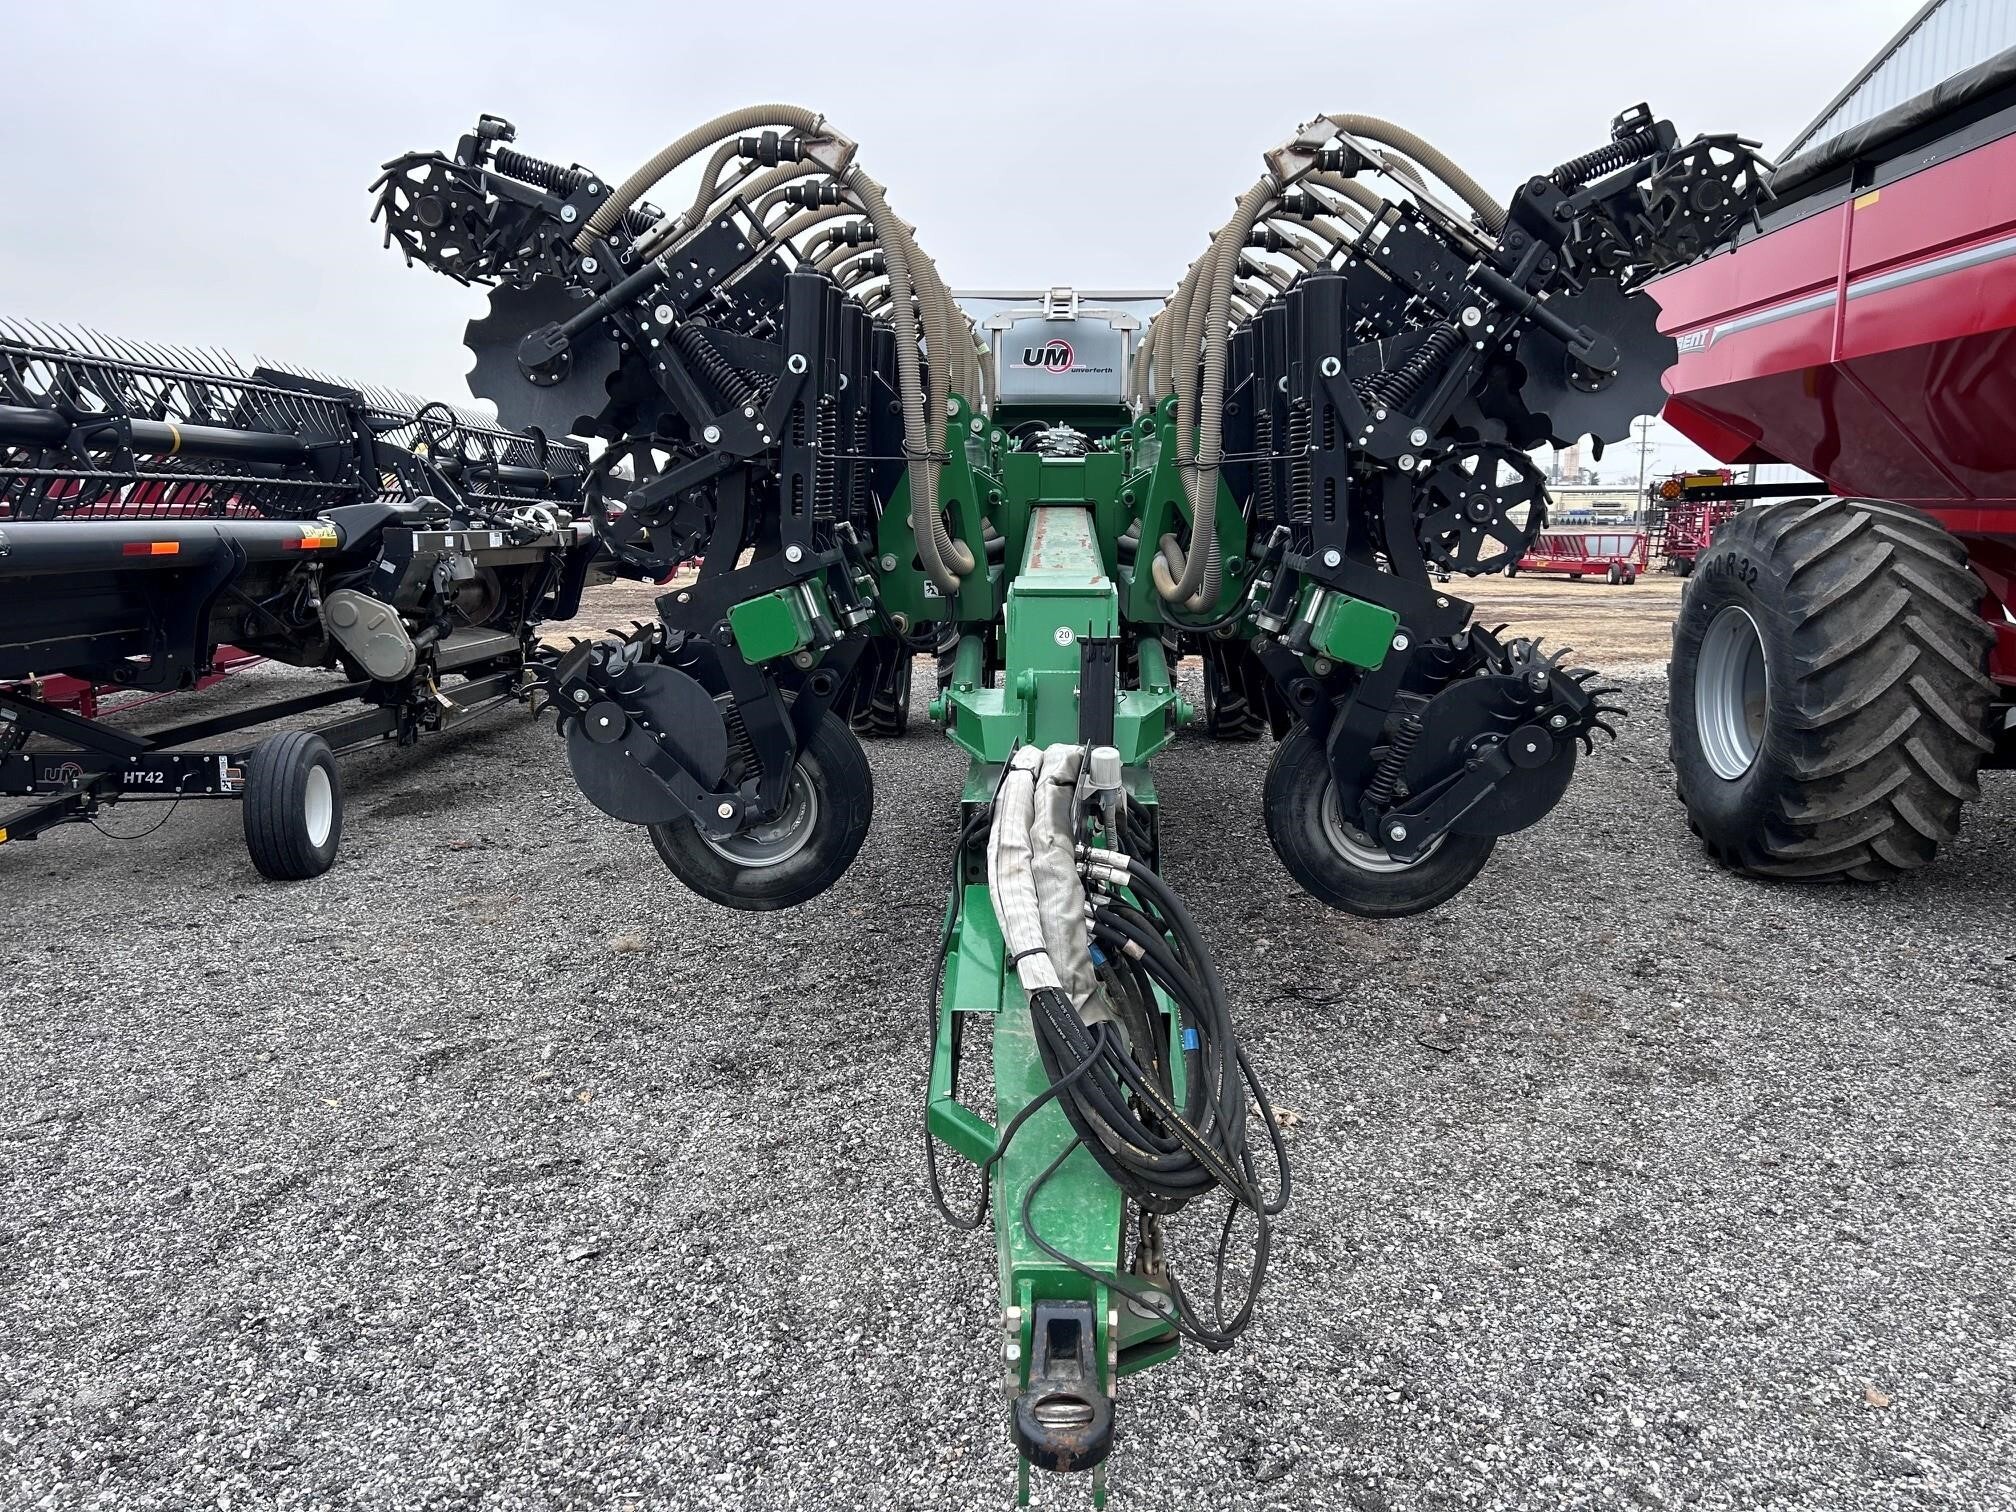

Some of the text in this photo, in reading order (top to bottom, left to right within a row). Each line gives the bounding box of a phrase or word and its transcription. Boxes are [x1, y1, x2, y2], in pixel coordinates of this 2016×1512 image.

[1022, 347, 1069, 367] UM
[1738, 558, 1758, 593] 32
[1058, 630, 1070, 639] 20
[123, 771, 164, 784] HT42
